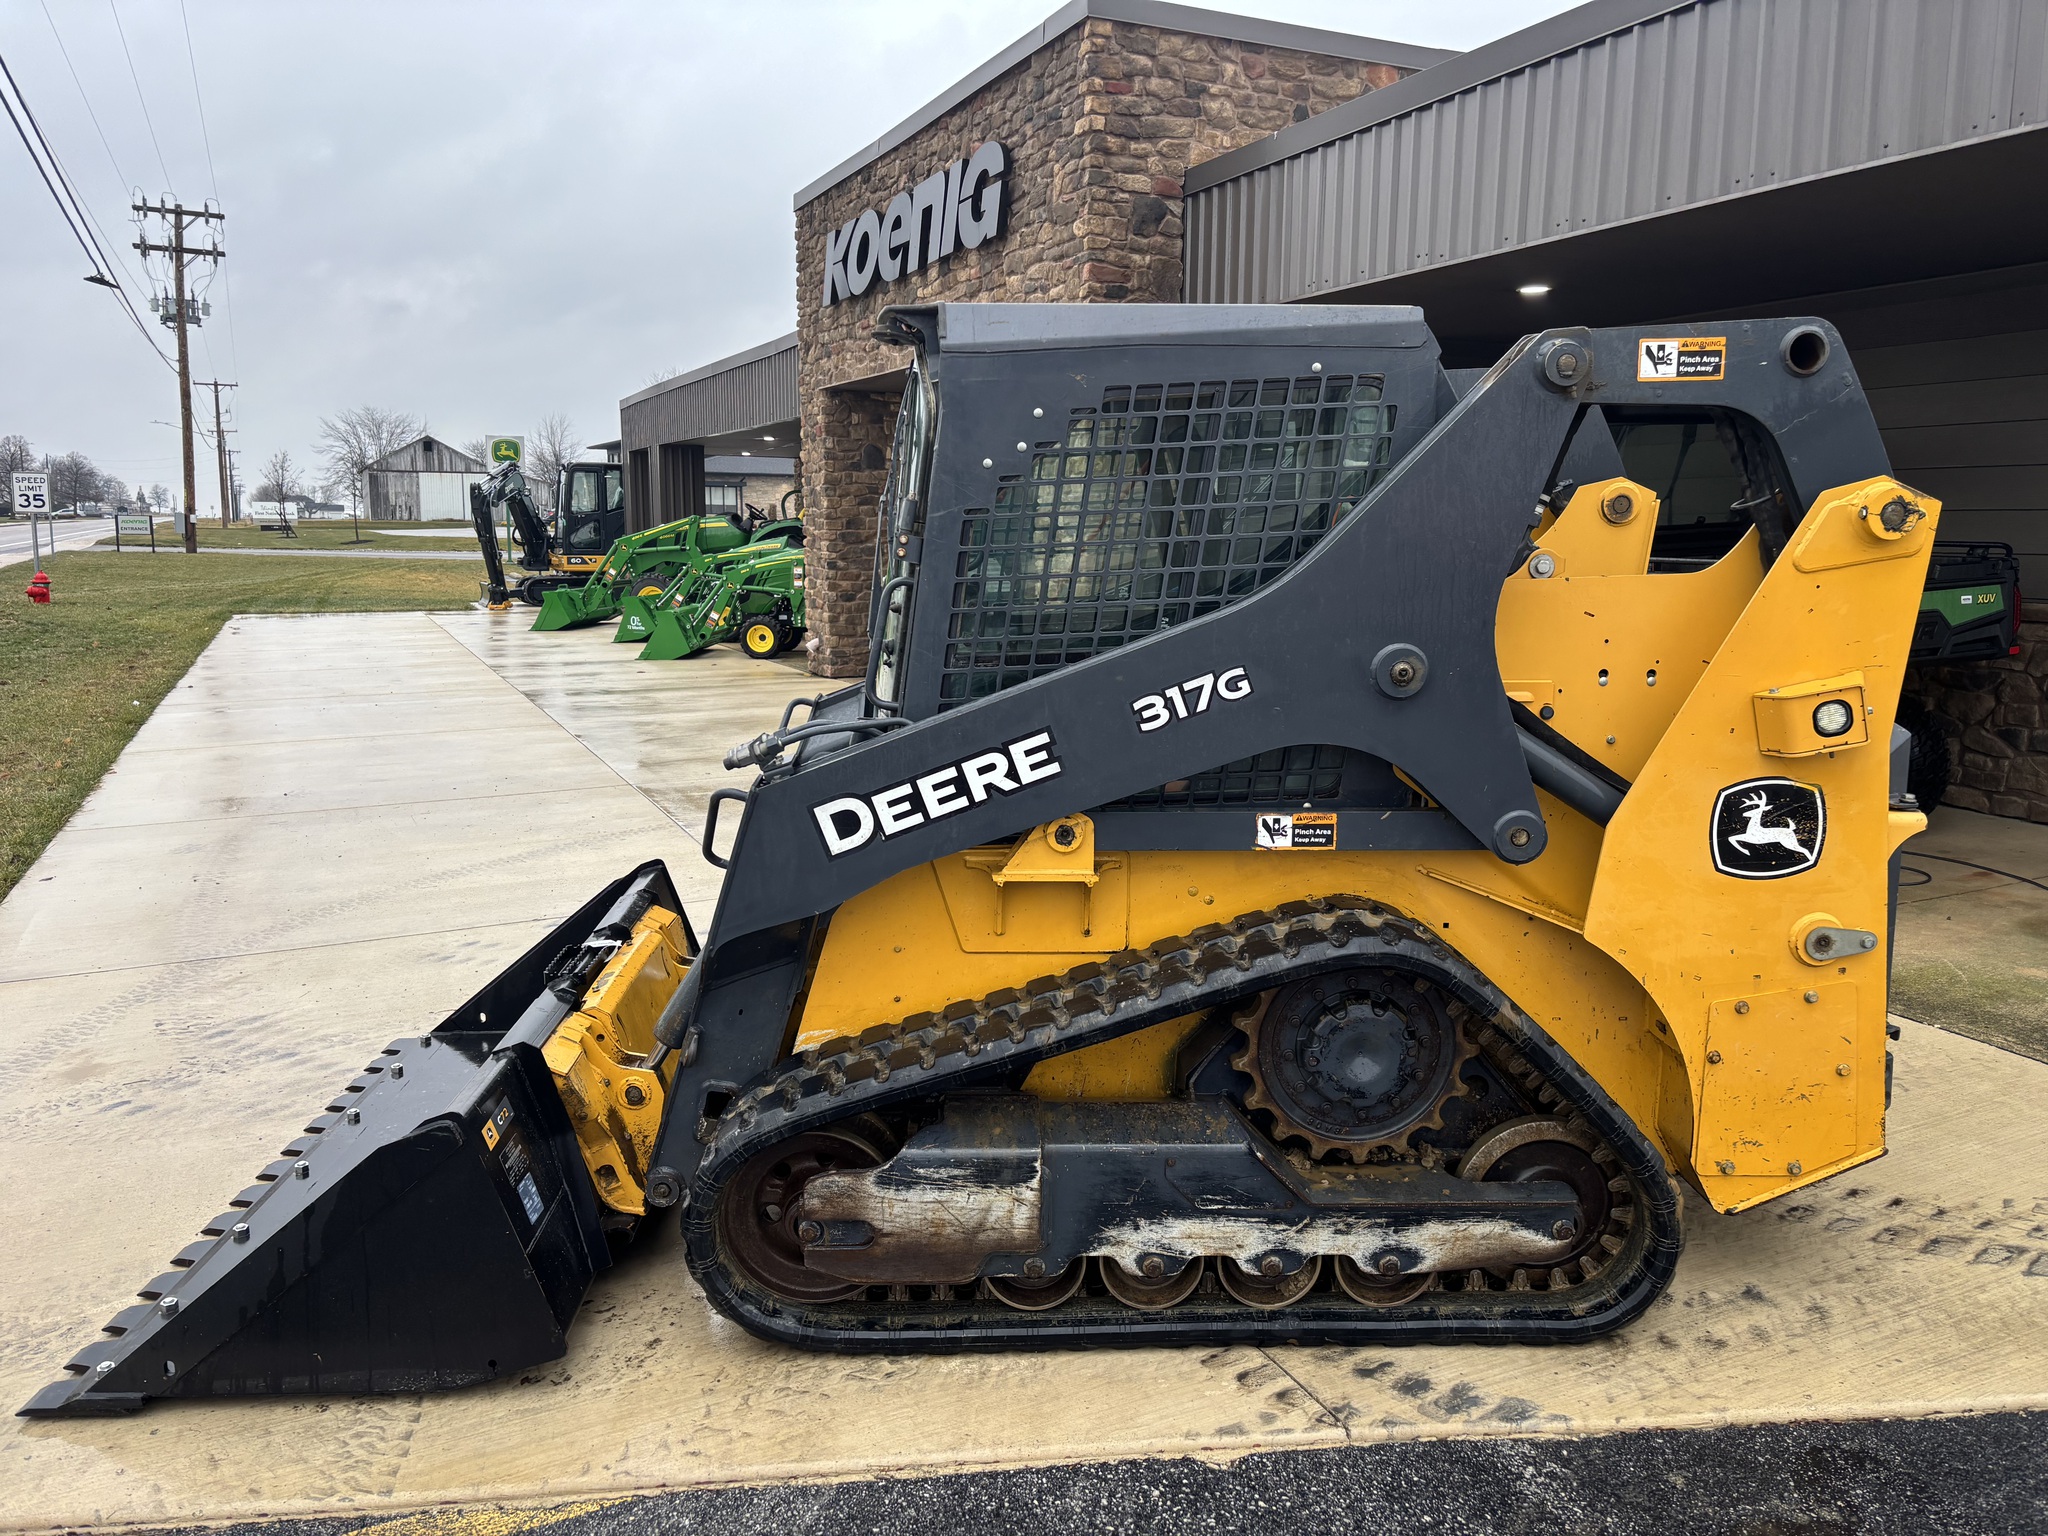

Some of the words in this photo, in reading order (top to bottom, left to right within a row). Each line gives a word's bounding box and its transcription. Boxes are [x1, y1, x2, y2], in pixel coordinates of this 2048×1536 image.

[1688, 340, 1722, 348] WARNING
[1679, 365, 1696, 373] Keep
[1696, 365, 1714, 373] Away
[18, 493, 46, 509] 35
[1977, 593, 1997, 604] XUV
[1132, 667, 1252, 732] 317G
[813, 731, 1062, 856] DEERE
[497, 1107, 509, 1125] C72
